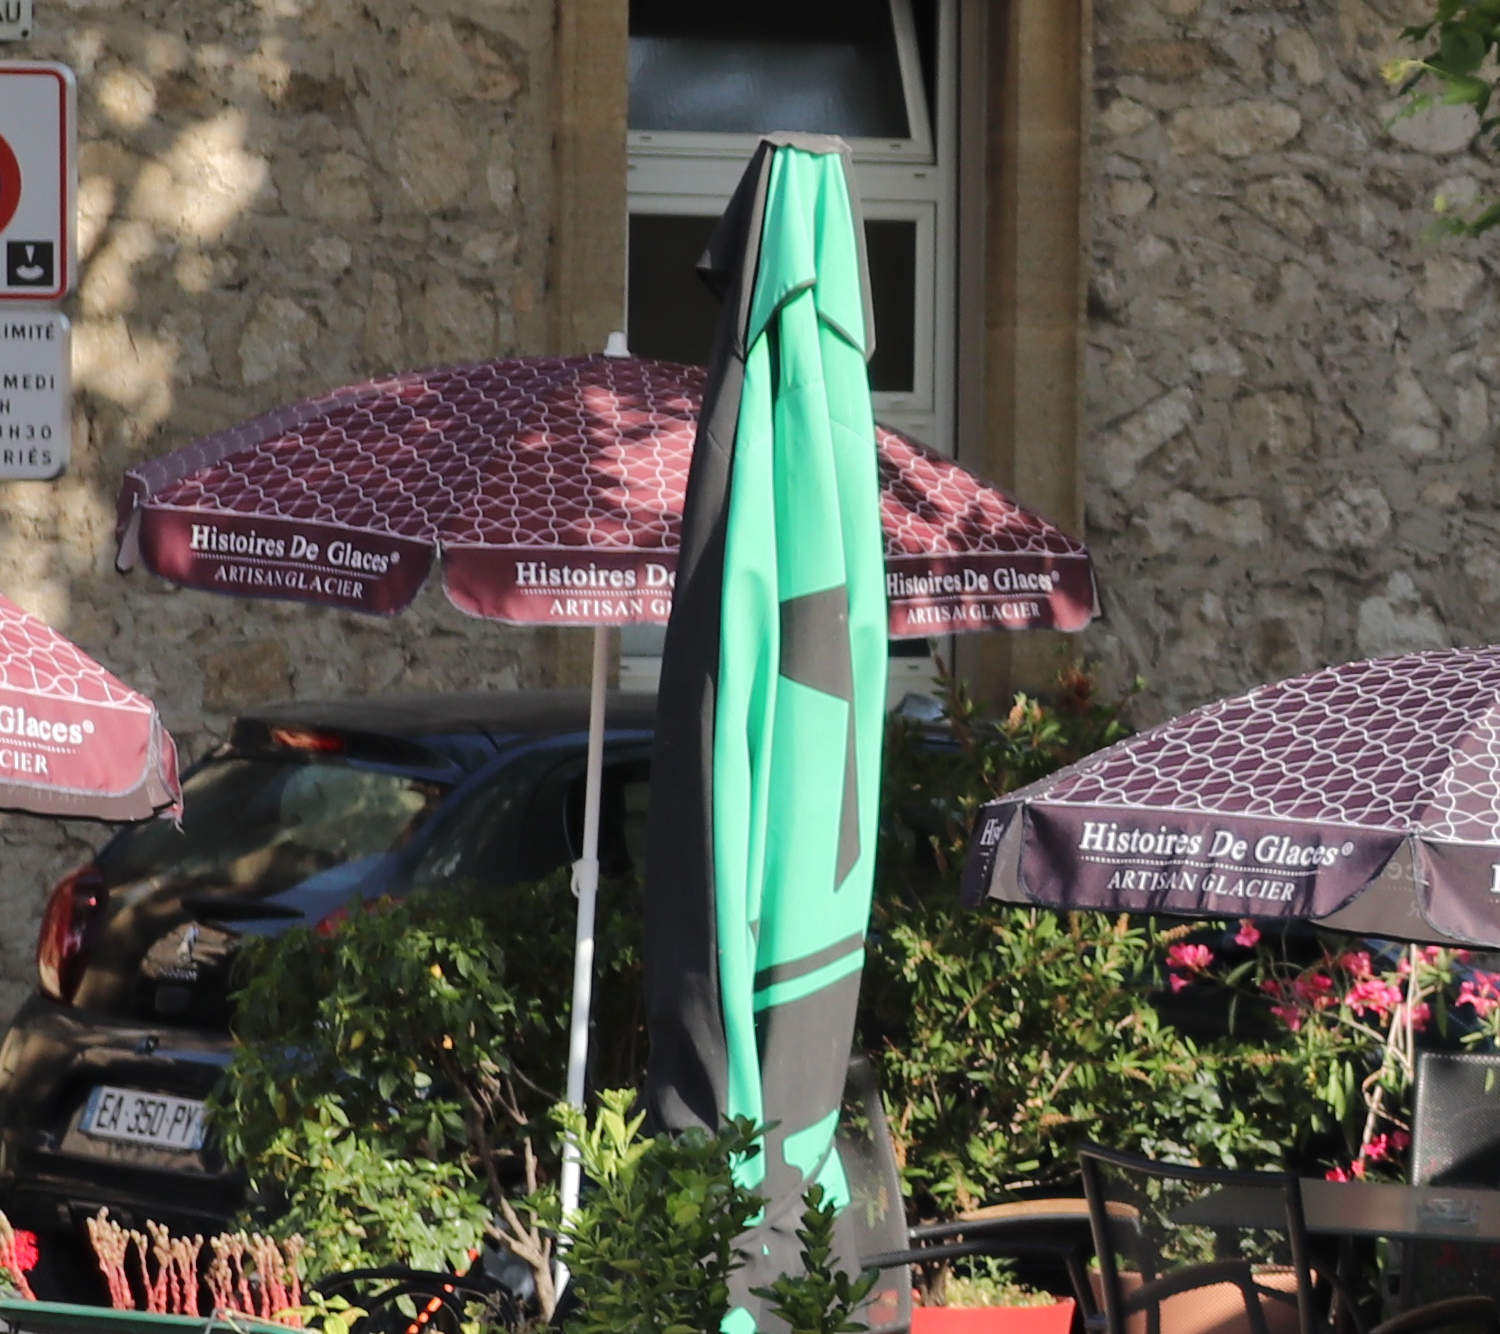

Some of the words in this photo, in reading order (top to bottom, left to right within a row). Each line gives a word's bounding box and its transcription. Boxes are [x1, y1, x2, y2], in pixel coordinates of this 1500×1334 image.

[0, 321, 55, 340] IMITÉ
[189, 524, 284, 557] Histoires
[290, 535, 319, 561] De
[215, 564, 282, 586] ARTISAN
[285, 568, 363, 599] GLACIER
[515, 561, 636, 588] Histoires
[887, 570, 961, 597] Histoires
[963, 568, 989, 592] De
[550, 598, 643, 616] ARTISAN
[969, 601, 1041, 624] GLACIER
[1079, 822, 1201, 856] Histoires
[1208, 830, 1248, 861] De
[1108, 870, 1198, 893] ARTISAN
[1202, 874, 1296, 902] GLACIER
